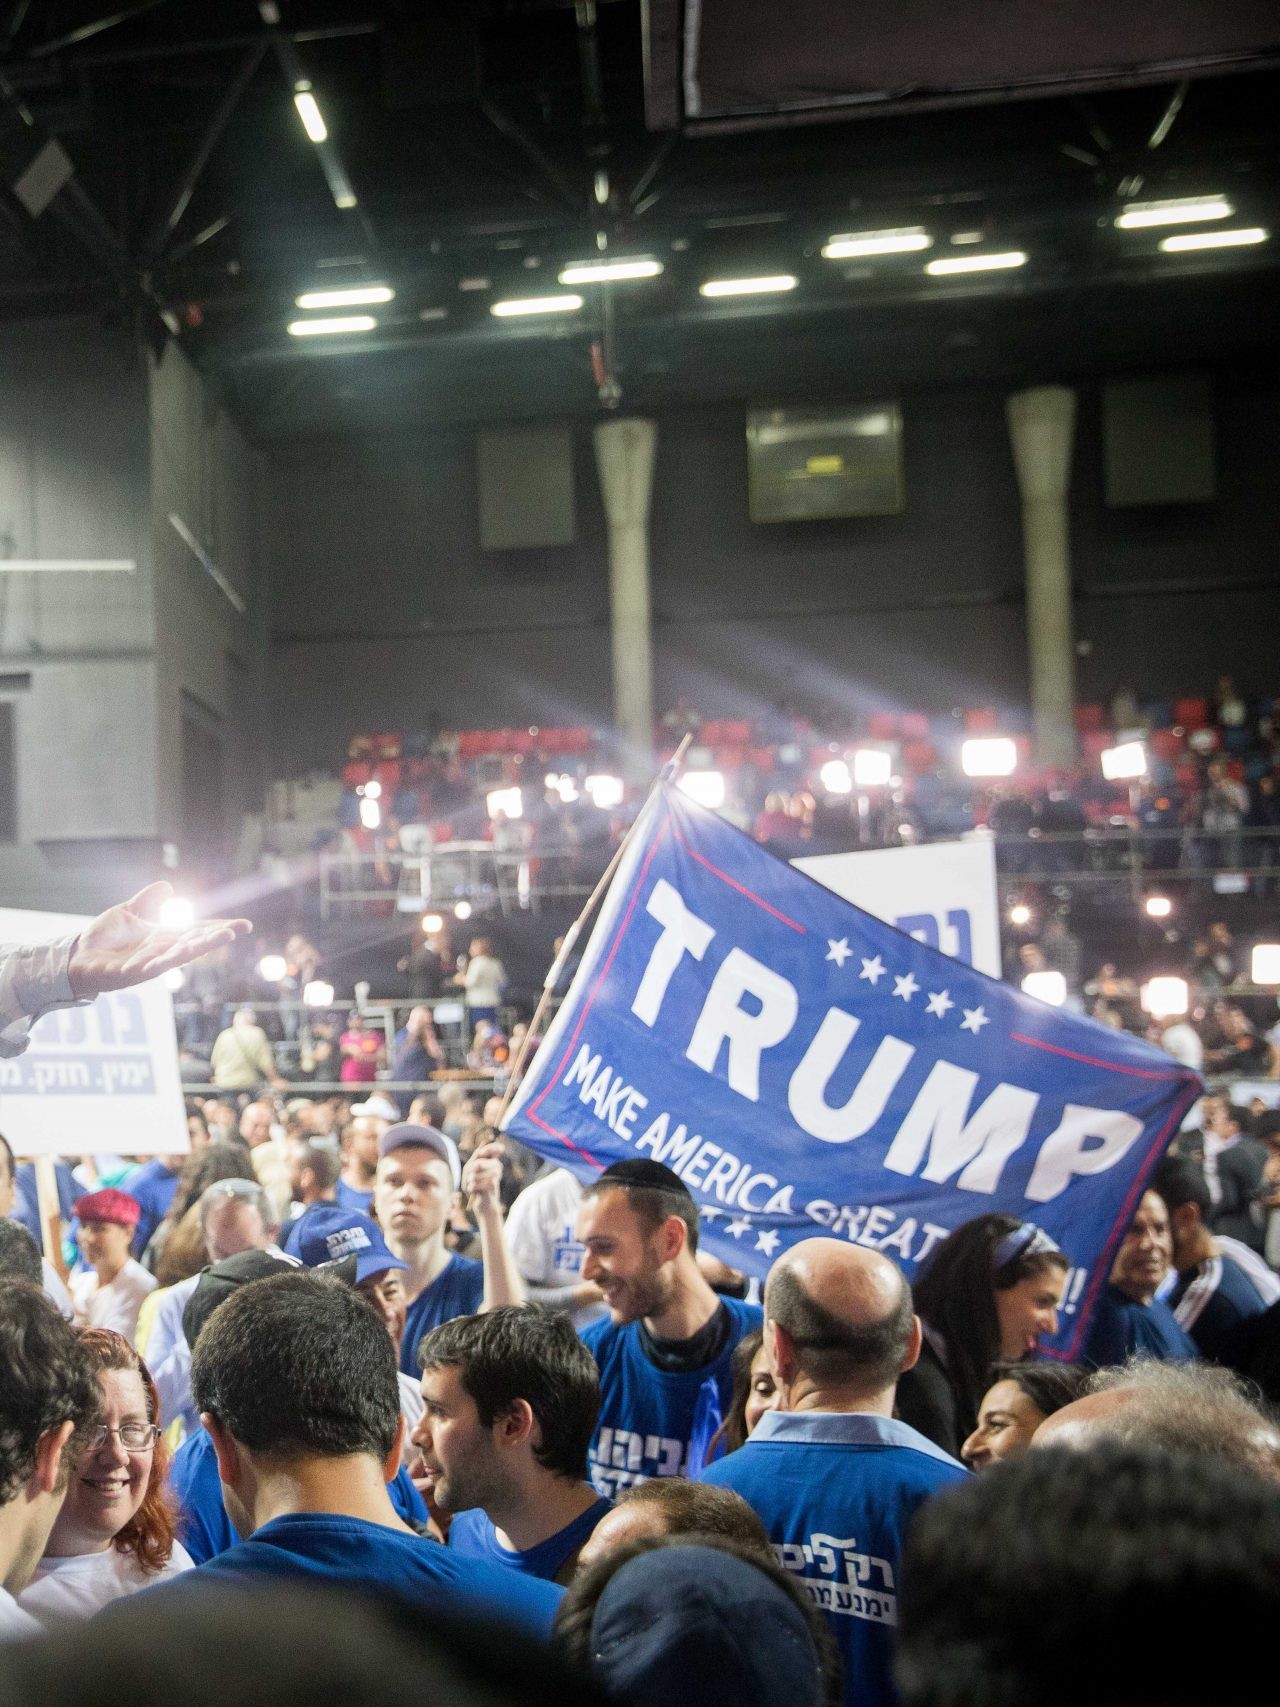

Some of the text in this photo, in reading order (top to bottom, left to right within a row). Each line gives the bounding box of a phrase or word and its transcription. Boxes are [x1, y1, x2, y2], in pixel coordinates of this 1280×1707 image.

[631, 877, 1145, 1203] TRUMP
[562, 1043, 649, 1140] MAKE
[635, 1111, 796, 1217] AMERICA
[836, 1591, 891, 1618] ימנע
[844, 1550, 895, 1590] רק
